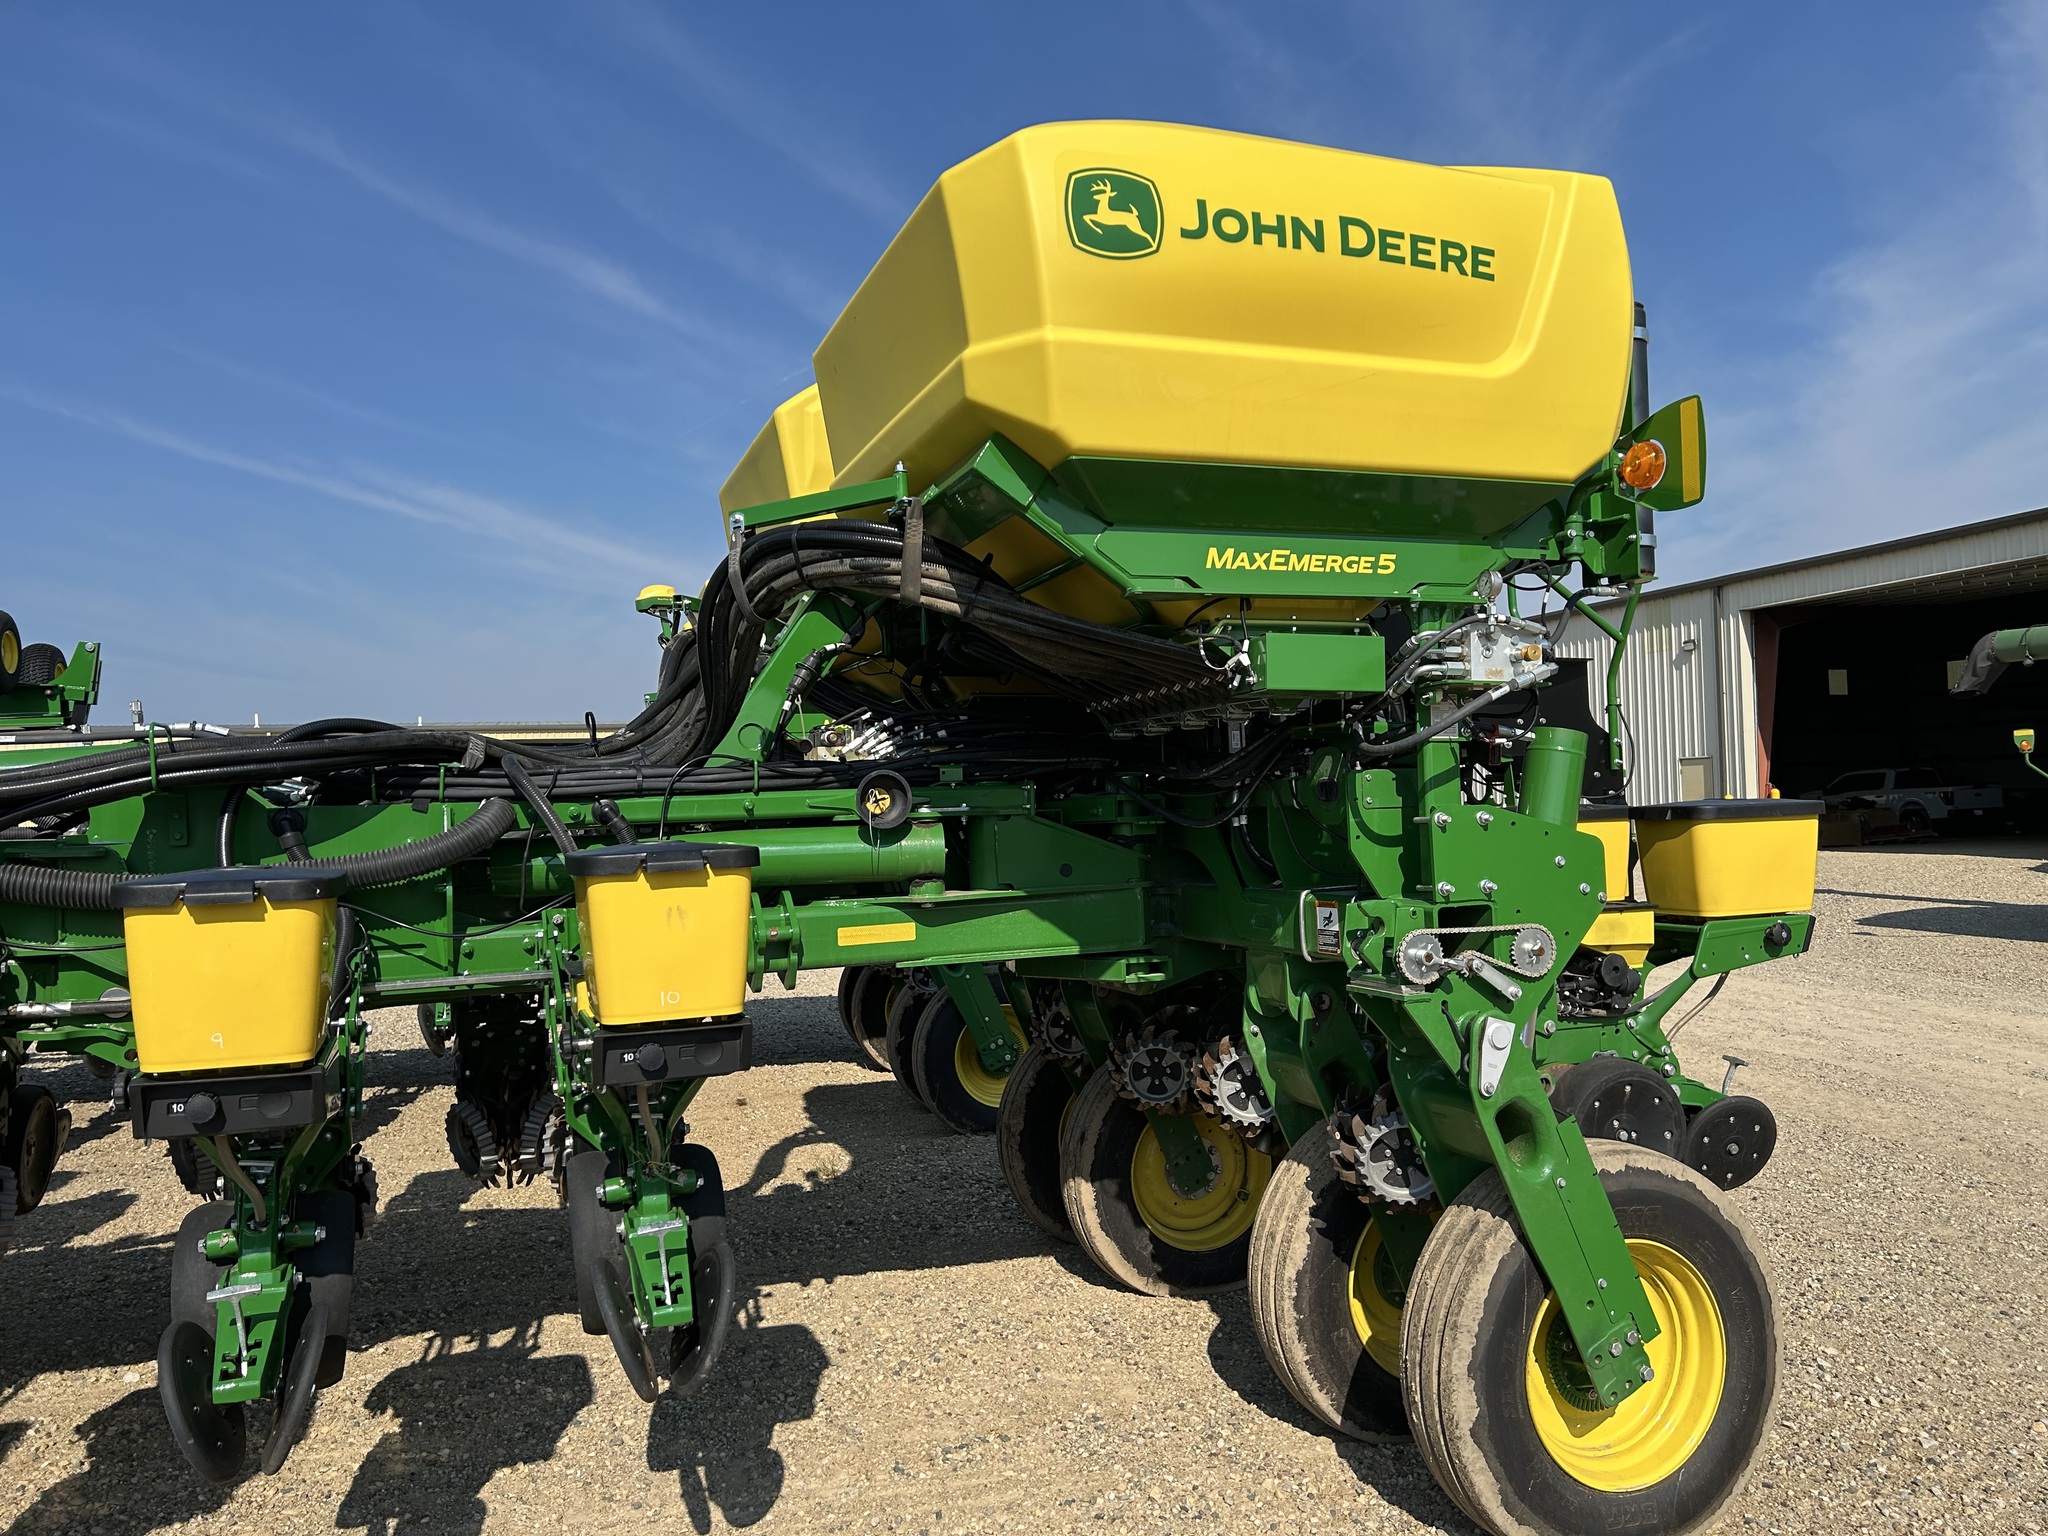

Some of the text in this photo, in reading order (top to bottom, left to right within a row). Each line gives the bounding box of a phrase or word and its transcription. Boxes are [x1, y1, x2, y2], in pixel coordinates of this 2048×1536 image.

[1180, 198, 1496, 282] JOHN DEERE
[1377, 553, 1397, 574] 5
[660, 991, 680, 1006] 10
[211, 1032, 223, 1050] 9
[623, 1053, 635, 1062] 10
[172, 1103, 184, 1113] 10
